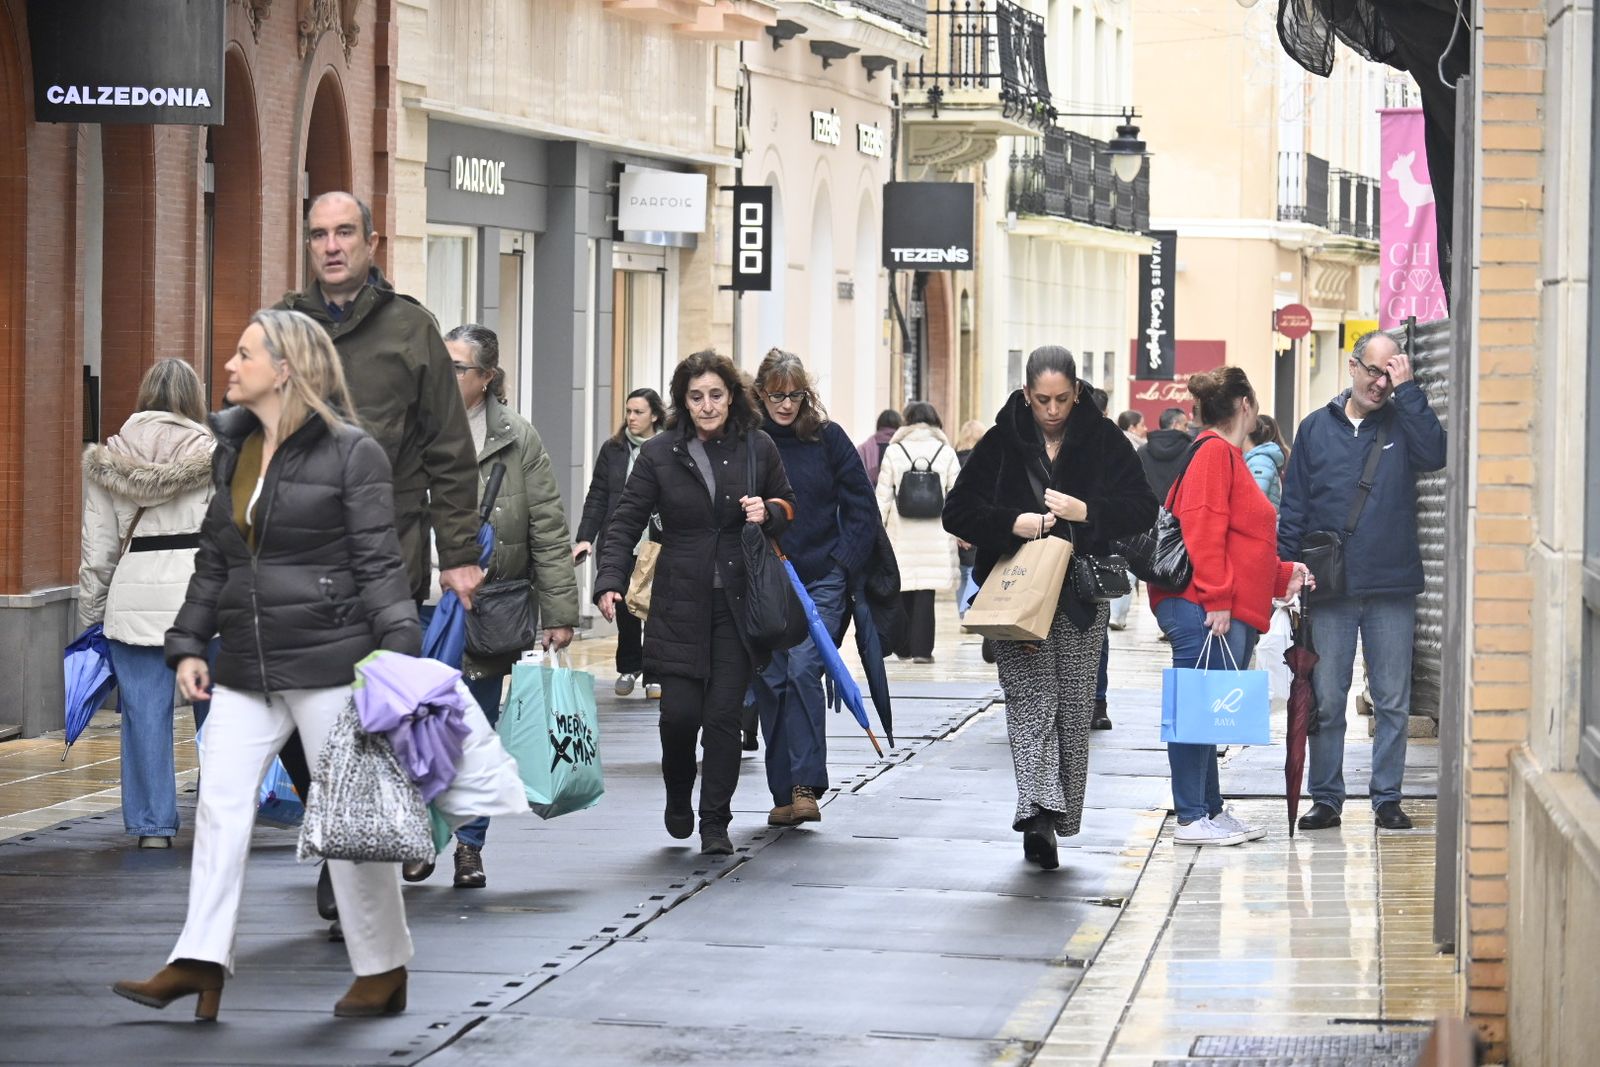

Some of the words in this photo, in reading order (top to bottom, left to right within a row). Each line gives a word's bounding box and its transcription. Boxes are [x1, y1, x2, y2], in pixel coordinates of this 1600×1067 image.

[47, 85, 211, 107] CALZEDONIA
[455, 155, 506, 196] PARFOIS
[630, 196, 692, 208] PARFOIS
[890, 245, 969, 263] TEZENIS
[1387, 295, 1449, 320] GUA
[1214, 717, 1236, 727] RAYA
[550, 733, 596, 773] XMAS
